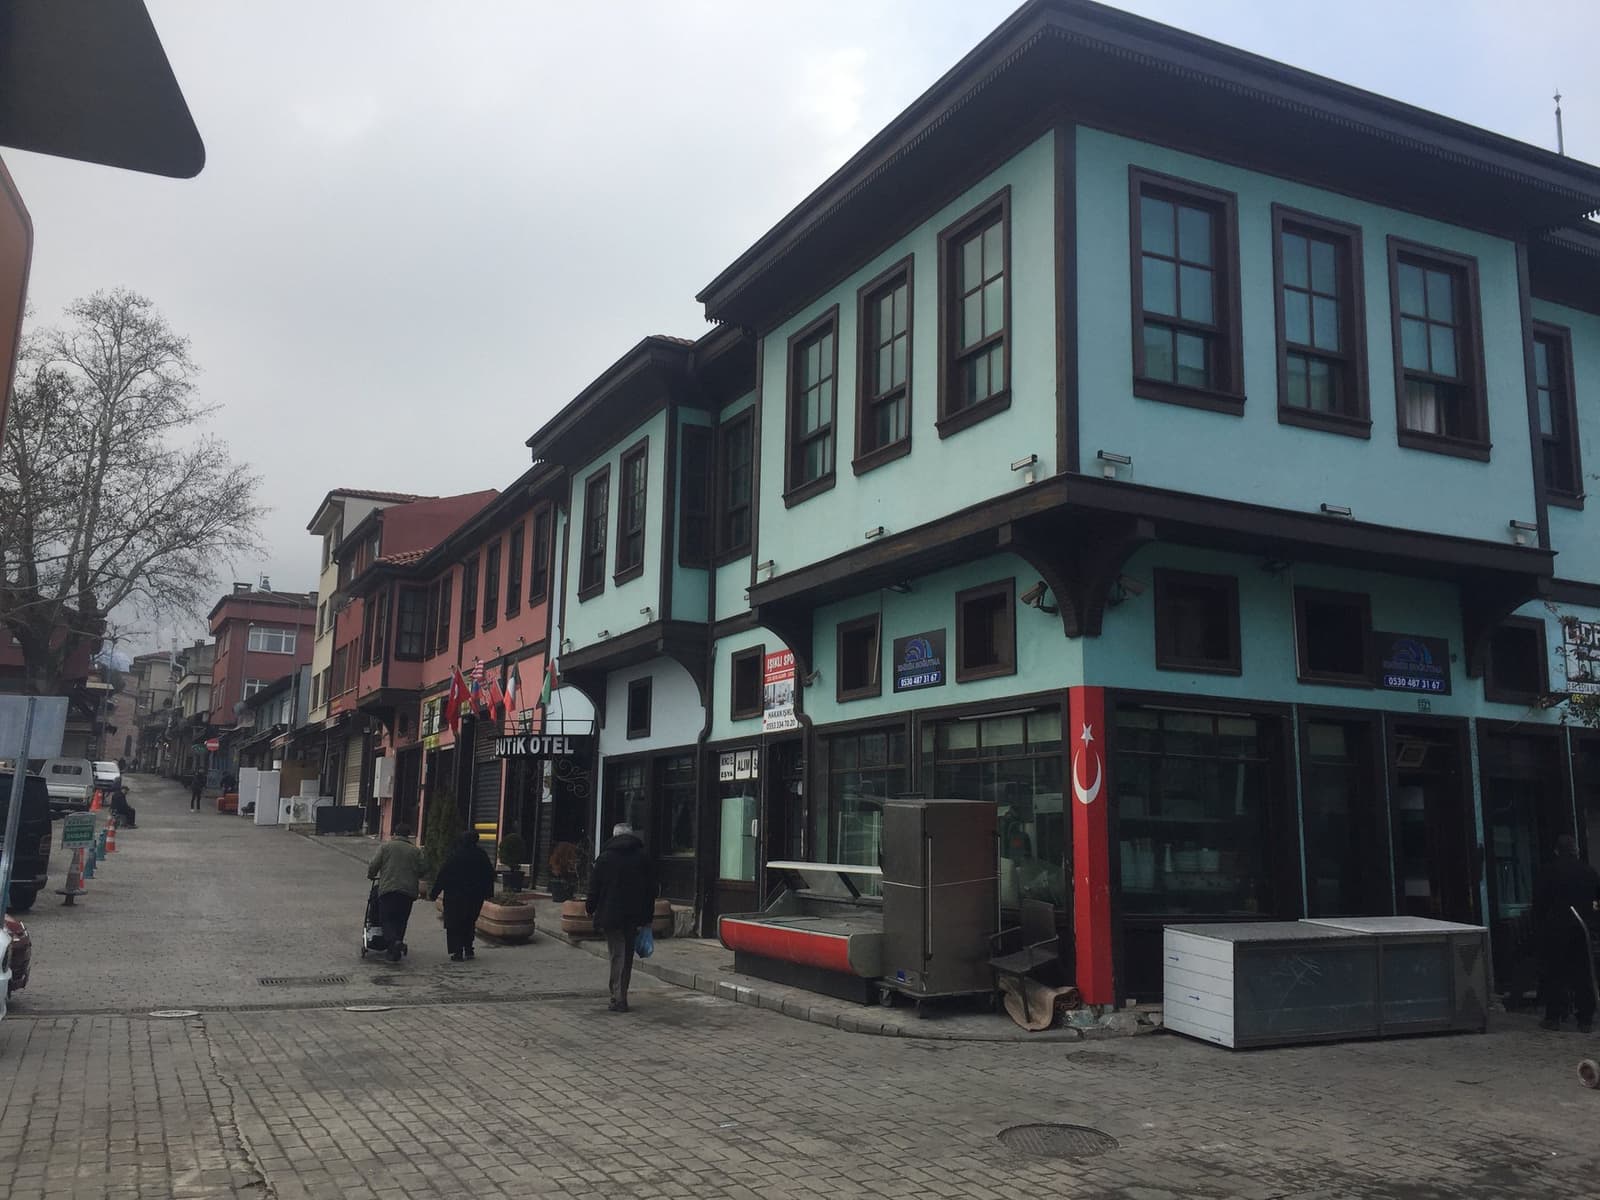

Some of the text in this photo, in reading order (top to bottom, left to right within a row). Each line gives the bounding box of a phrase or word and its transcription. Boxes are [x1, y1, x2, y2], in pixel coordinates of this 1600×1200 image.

[900, 678, 912, 687] 0530
[1388, 677, 1440, 689] 0530 487 31 67
[530, 736, 574, 754] OTEL
